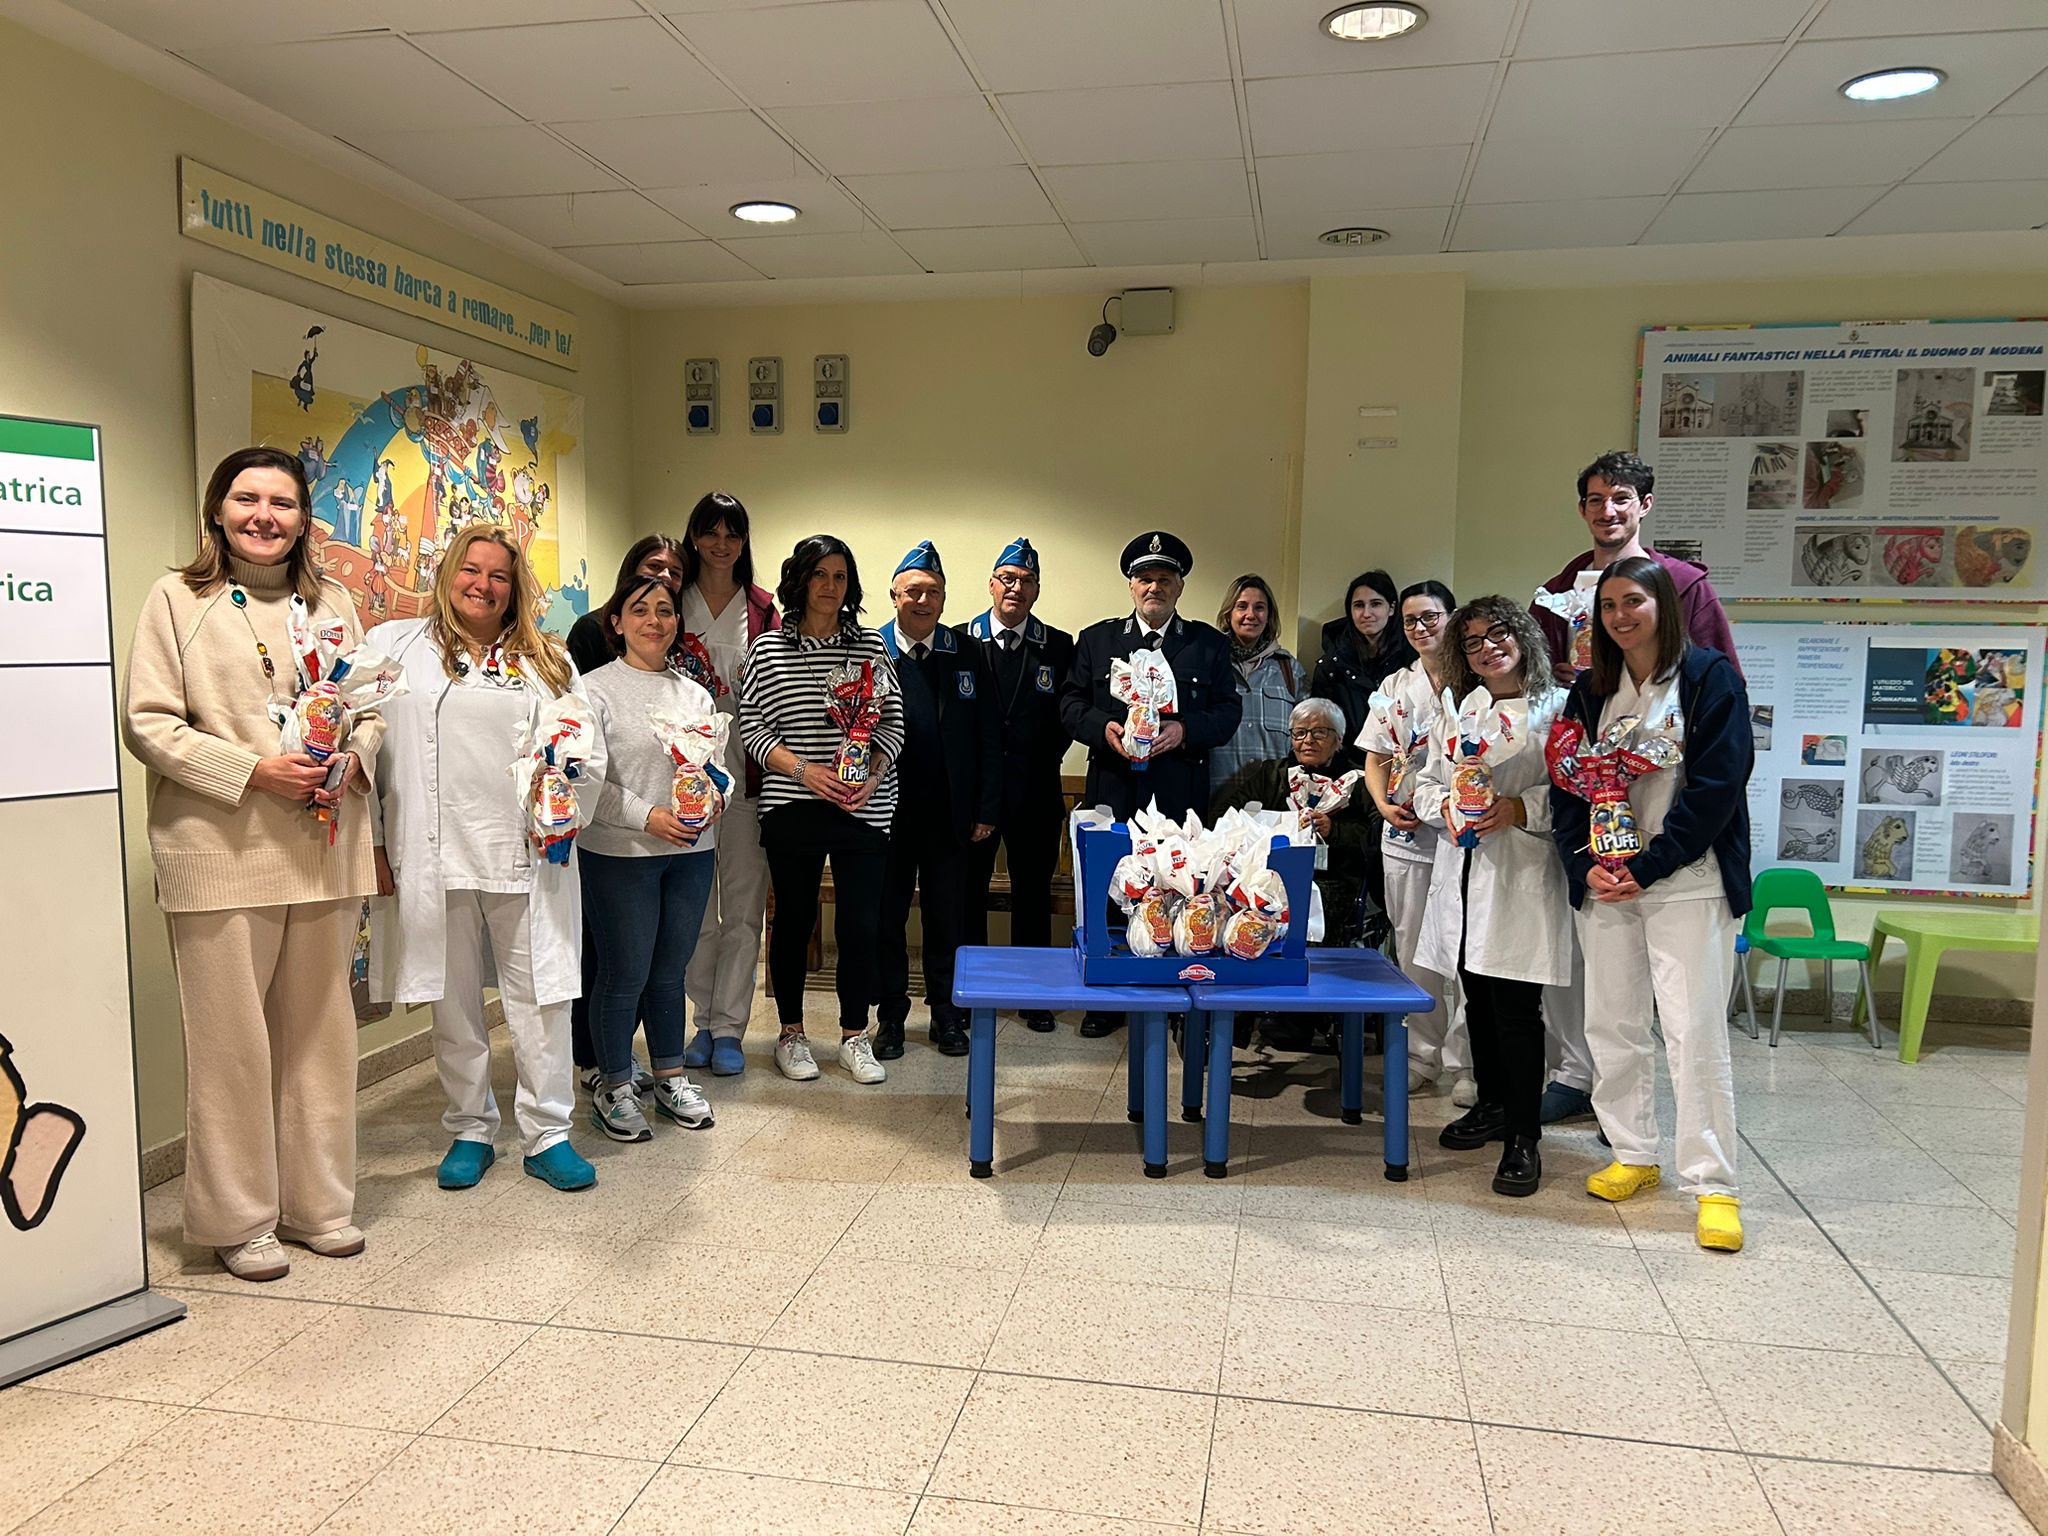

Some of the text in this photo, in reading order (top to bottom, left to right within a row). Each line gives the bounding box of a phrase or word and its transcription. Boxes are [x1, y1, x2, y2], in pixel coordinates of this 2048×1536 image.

[201, 189, 253, 239] tutti
[261, 218, 316, 263] nella
[324, 243, 387, 287] stessa
[394, 265, 442, 307] barca
[448, 289, 456, 313] a
[555, 328, 573, 356] te!
[1664, 345, 2044, 363] ANIMALI FANTASTICI NELLA PIETRA: IL DUOMO DI MODENA
